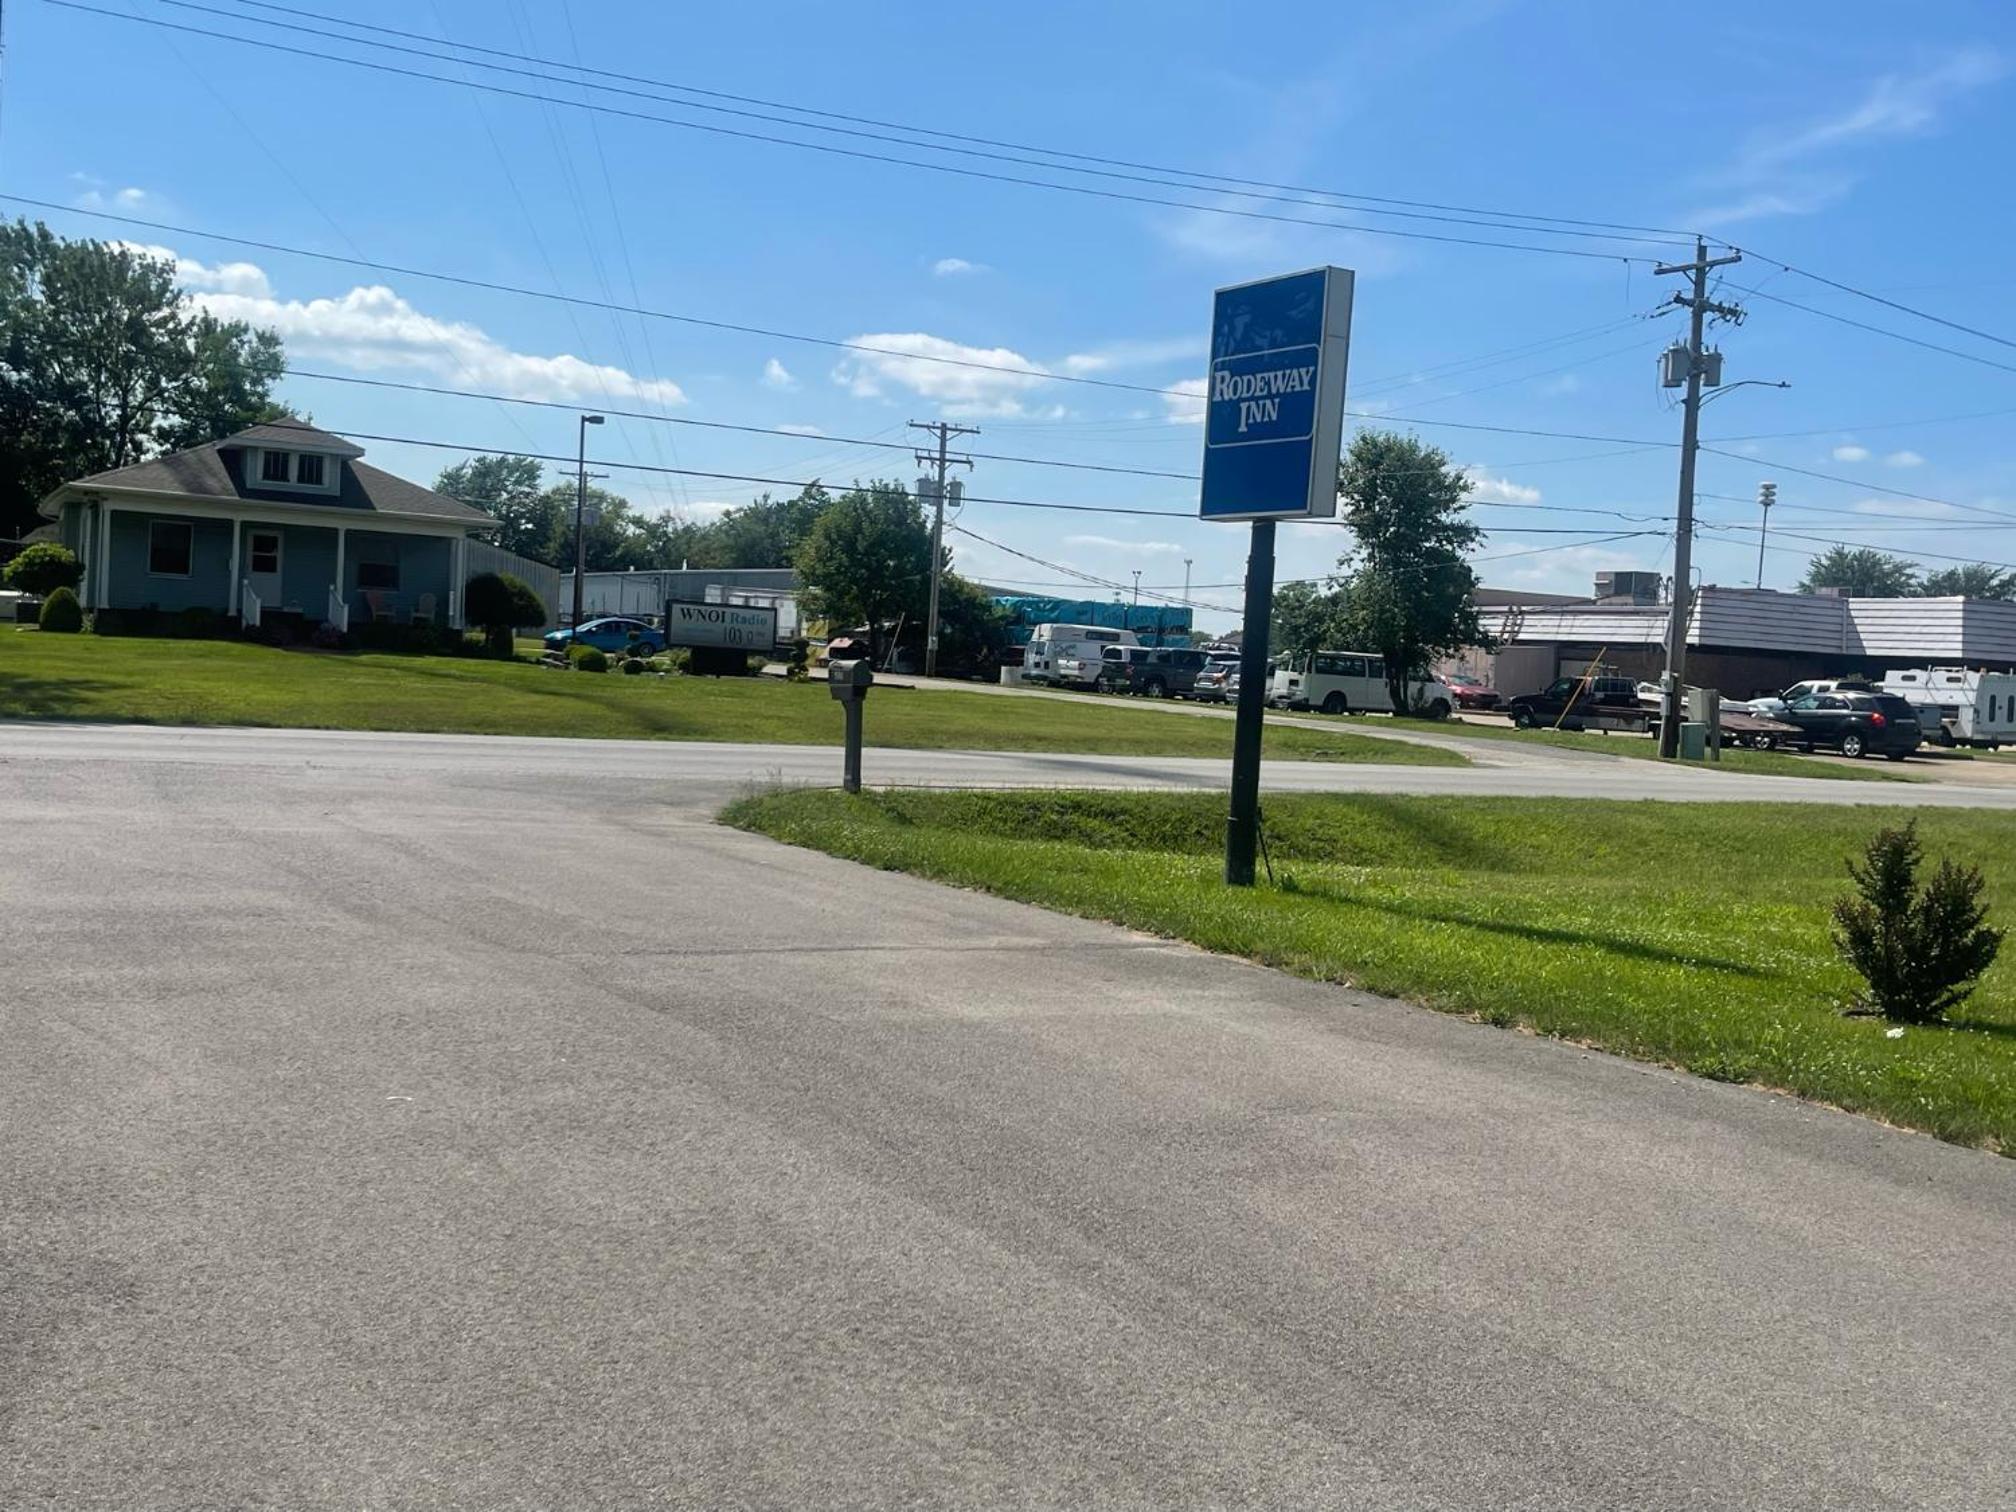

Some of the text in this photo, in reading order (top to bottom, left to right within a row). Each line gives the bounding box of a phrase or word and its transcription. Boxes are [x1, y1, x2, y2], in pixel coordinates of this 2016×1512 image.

[1212, 366, 1315, 402] RODEWAY
[1238, 398, 1280, 433] INN
[681, 607, 768, 625] WNOI Radio
